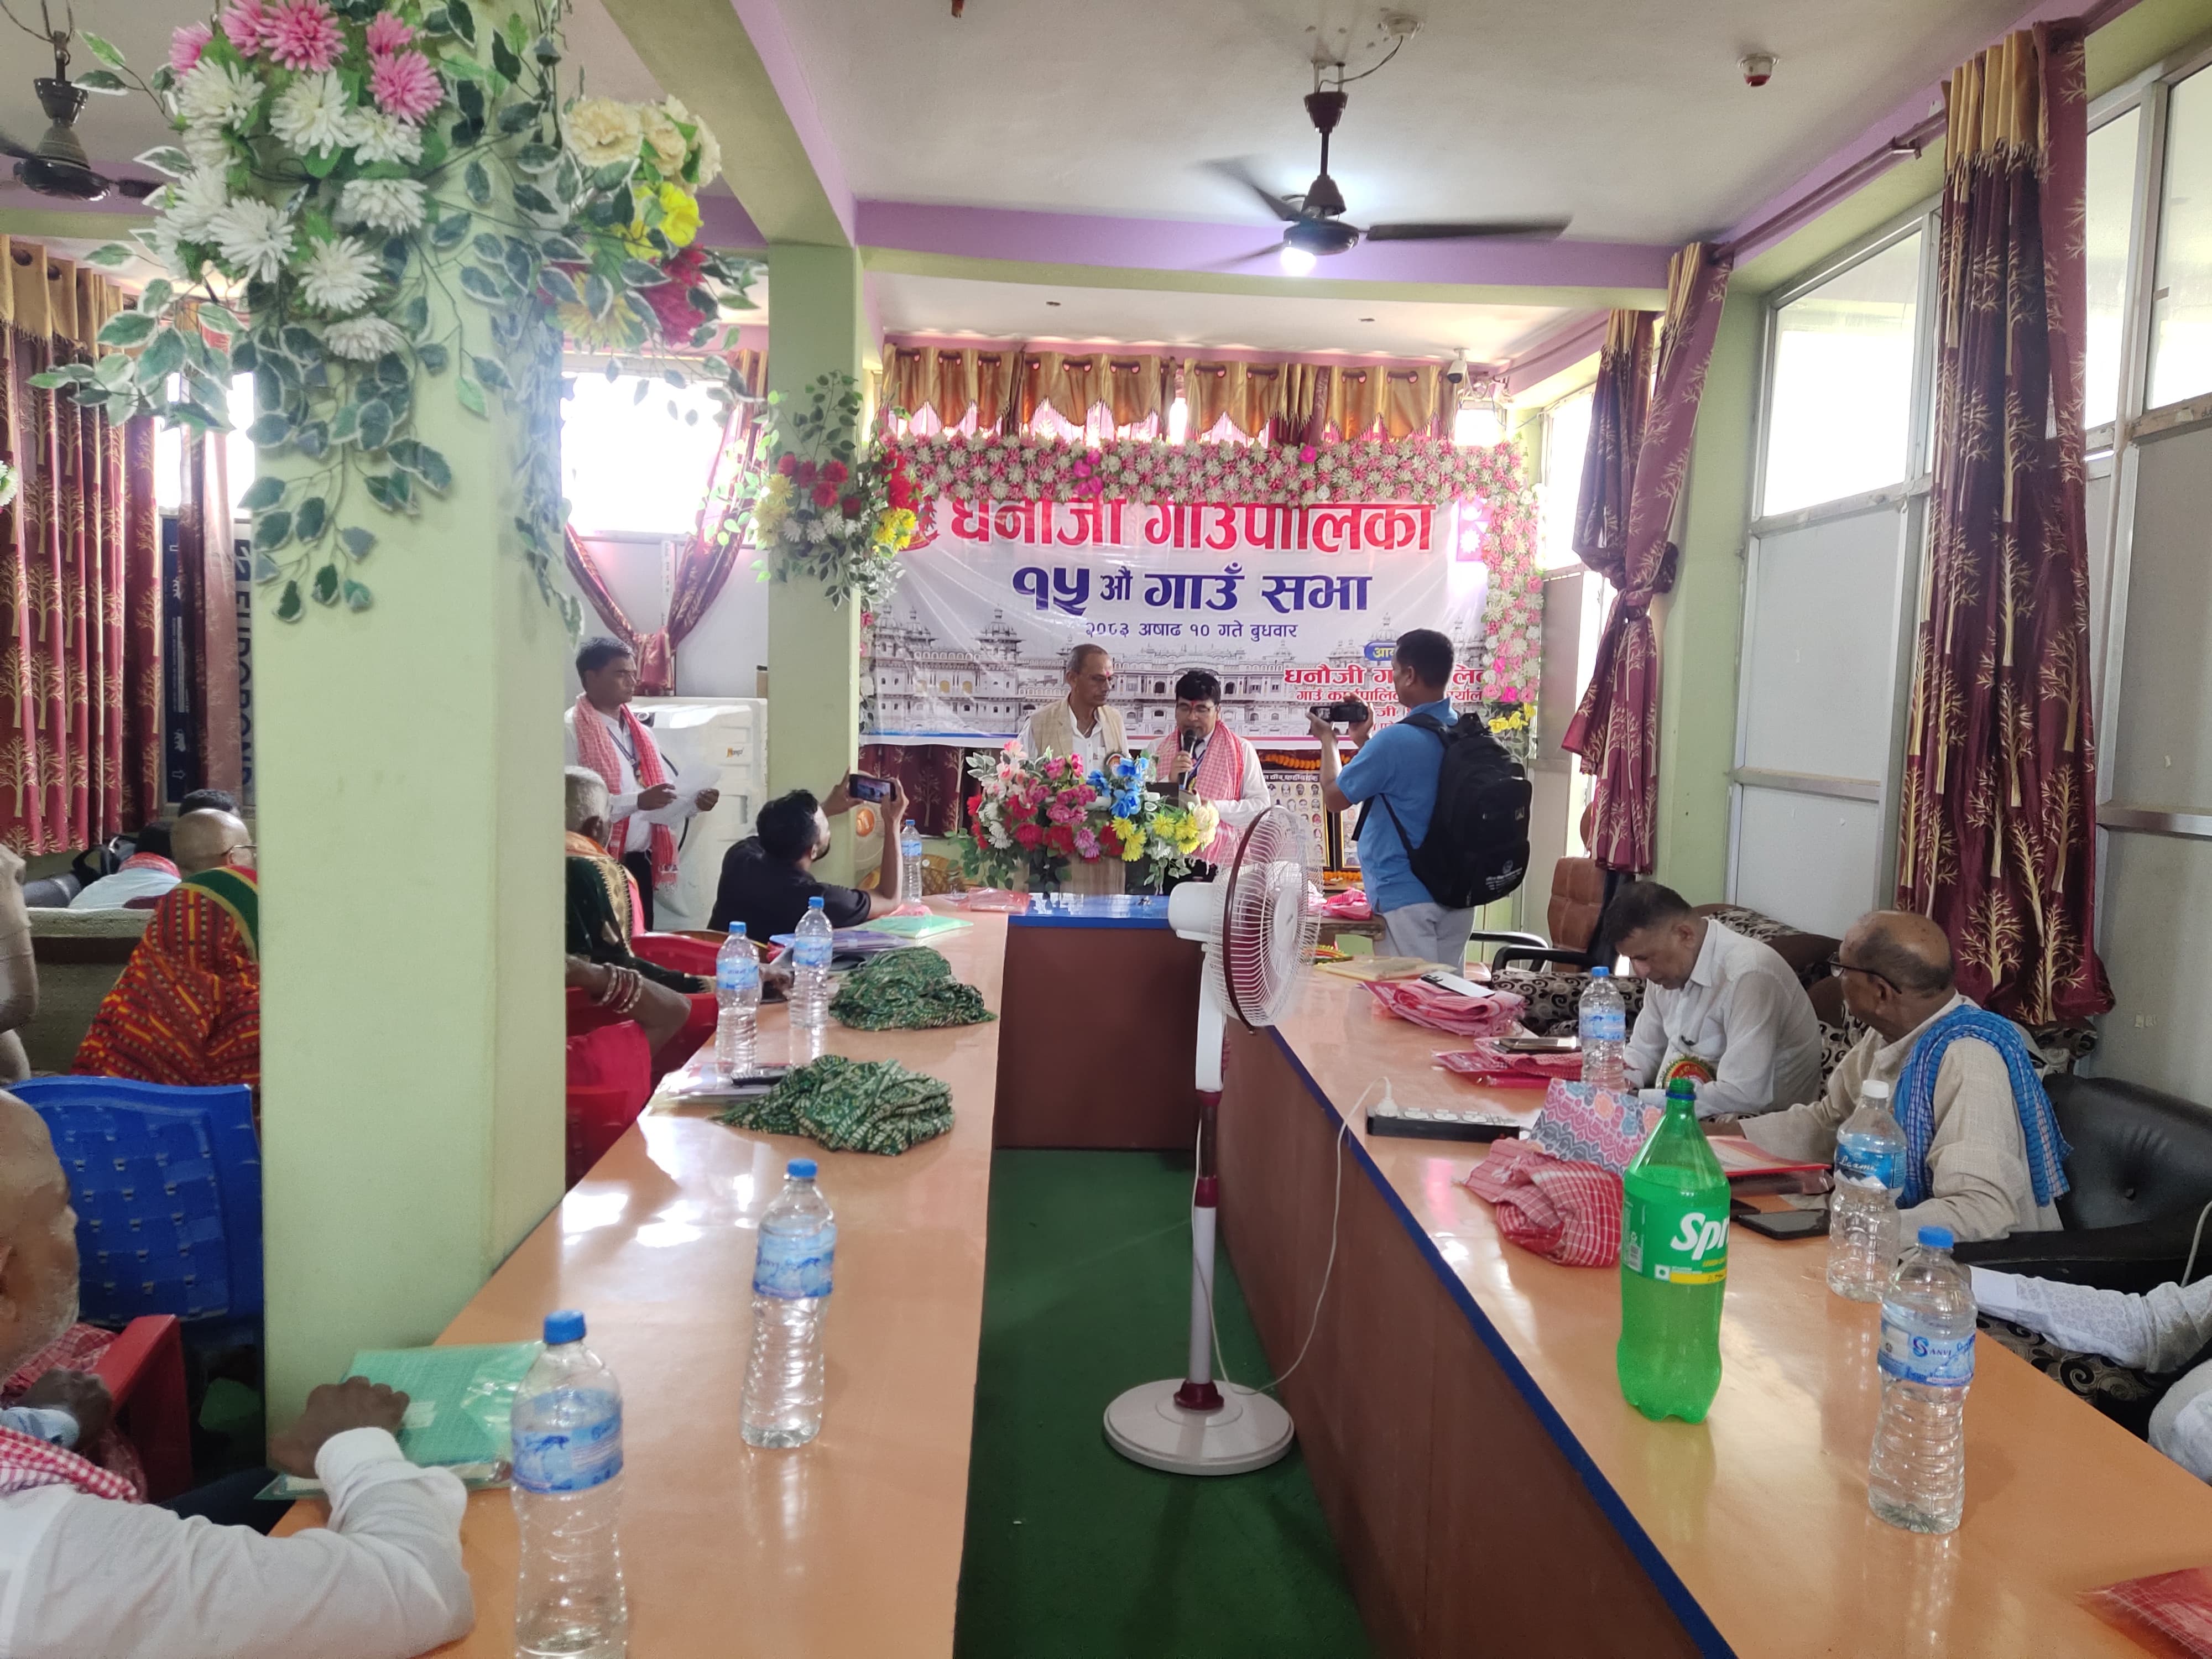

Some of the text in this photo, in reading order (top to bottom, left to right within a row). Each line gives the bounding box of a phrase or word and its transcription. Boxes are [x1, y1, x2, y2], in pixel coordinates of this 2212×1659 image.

[1013, 567, 1089, 615] १५
[1144, 562, 1245, 610] गाउँ
[1261, 576, 1373, 614] सभा
[1086, 620, 1298, 641] २०८३ अषाढ १० गते बुधवार
[1285, 664, 1365, 684] धनौजी
[1297, 688, 1323, 701] गाउँ
